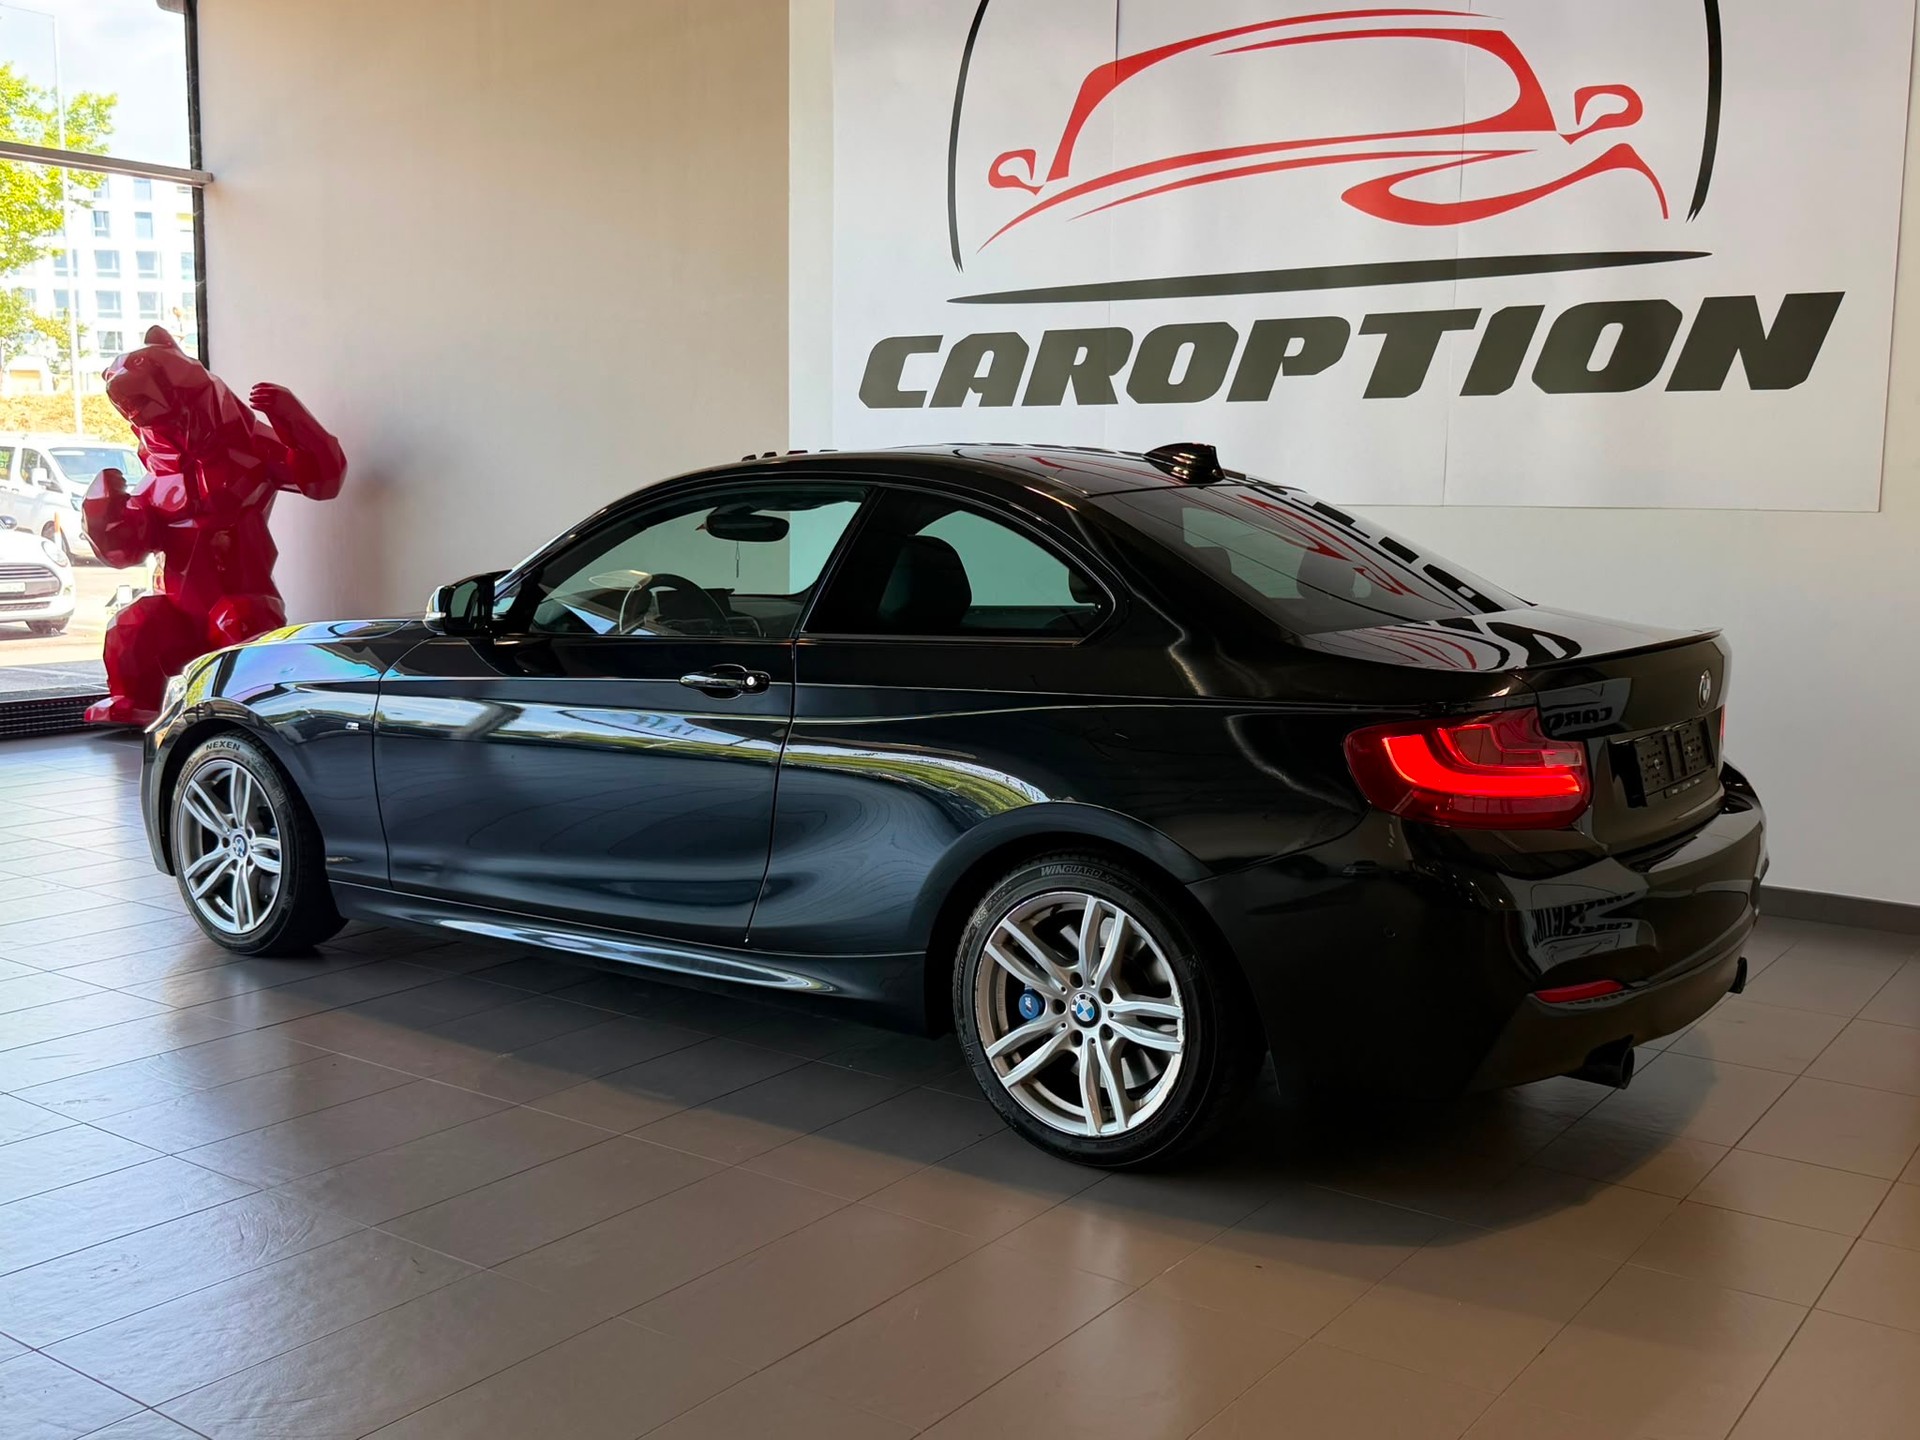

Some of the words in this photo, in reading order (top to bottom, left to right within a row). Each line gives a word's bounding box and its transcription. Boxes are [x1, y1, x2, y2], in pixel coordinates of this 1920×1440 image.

[858, 292, 1845, 409] CAROPTION
[205, 740, 241, 751] NEXEN
[1041, 864, 1103, 878] WINGUARD
